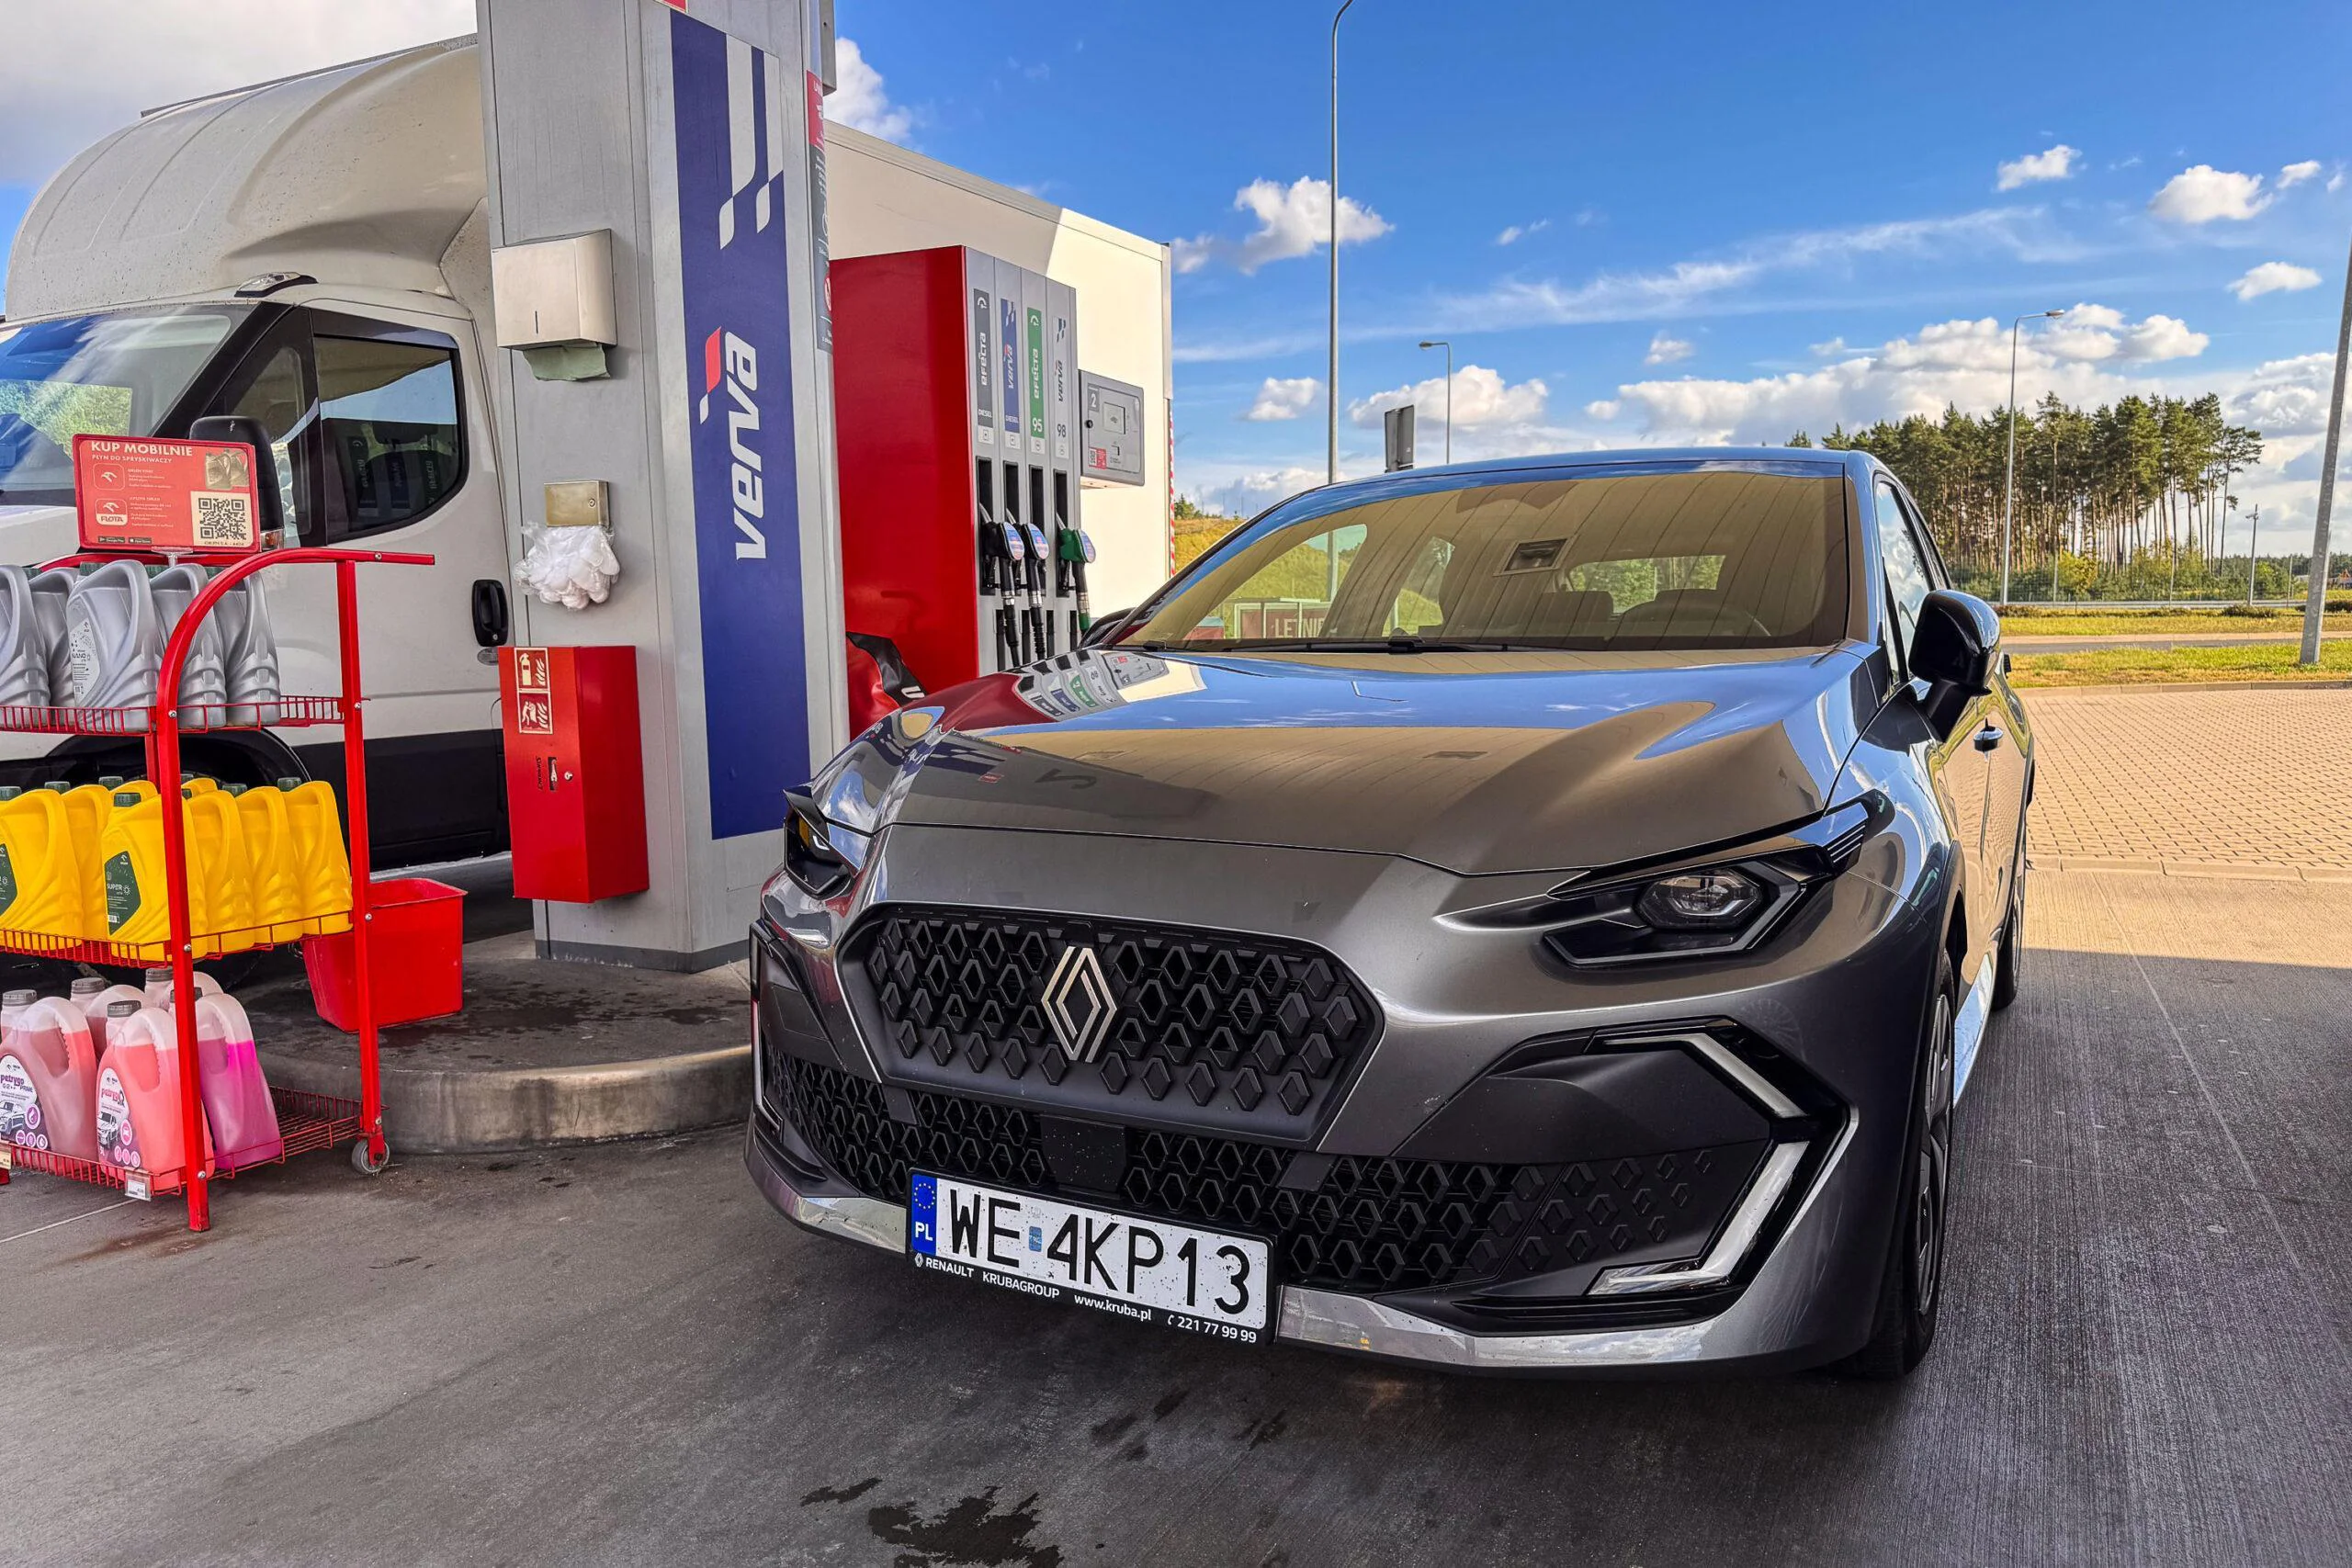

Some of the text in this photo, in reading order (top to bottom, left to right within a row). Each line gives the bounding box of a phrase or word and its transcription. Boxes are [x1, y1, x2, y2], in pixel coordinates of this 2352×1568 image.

[1090, 391, 1097, 408] 2
[978, 409, 992, 418] DIESEL
[1032, 417, 1043, 433] 95
[1057, 423, 1067, 437] 98
[91, 441, 193, 457] KUP MOBILNIE
[724, 331, 767, 560] verva
[107, 883, 123, 891] SUPER
[914, 1221, 933, 1242] PL
[949, 1189, 1250, 1315] WE 4KP13
[925, 1258, 1257, 1343] RENAULT KRUBAGROUP www.kruba.pl 221 77 99 99
